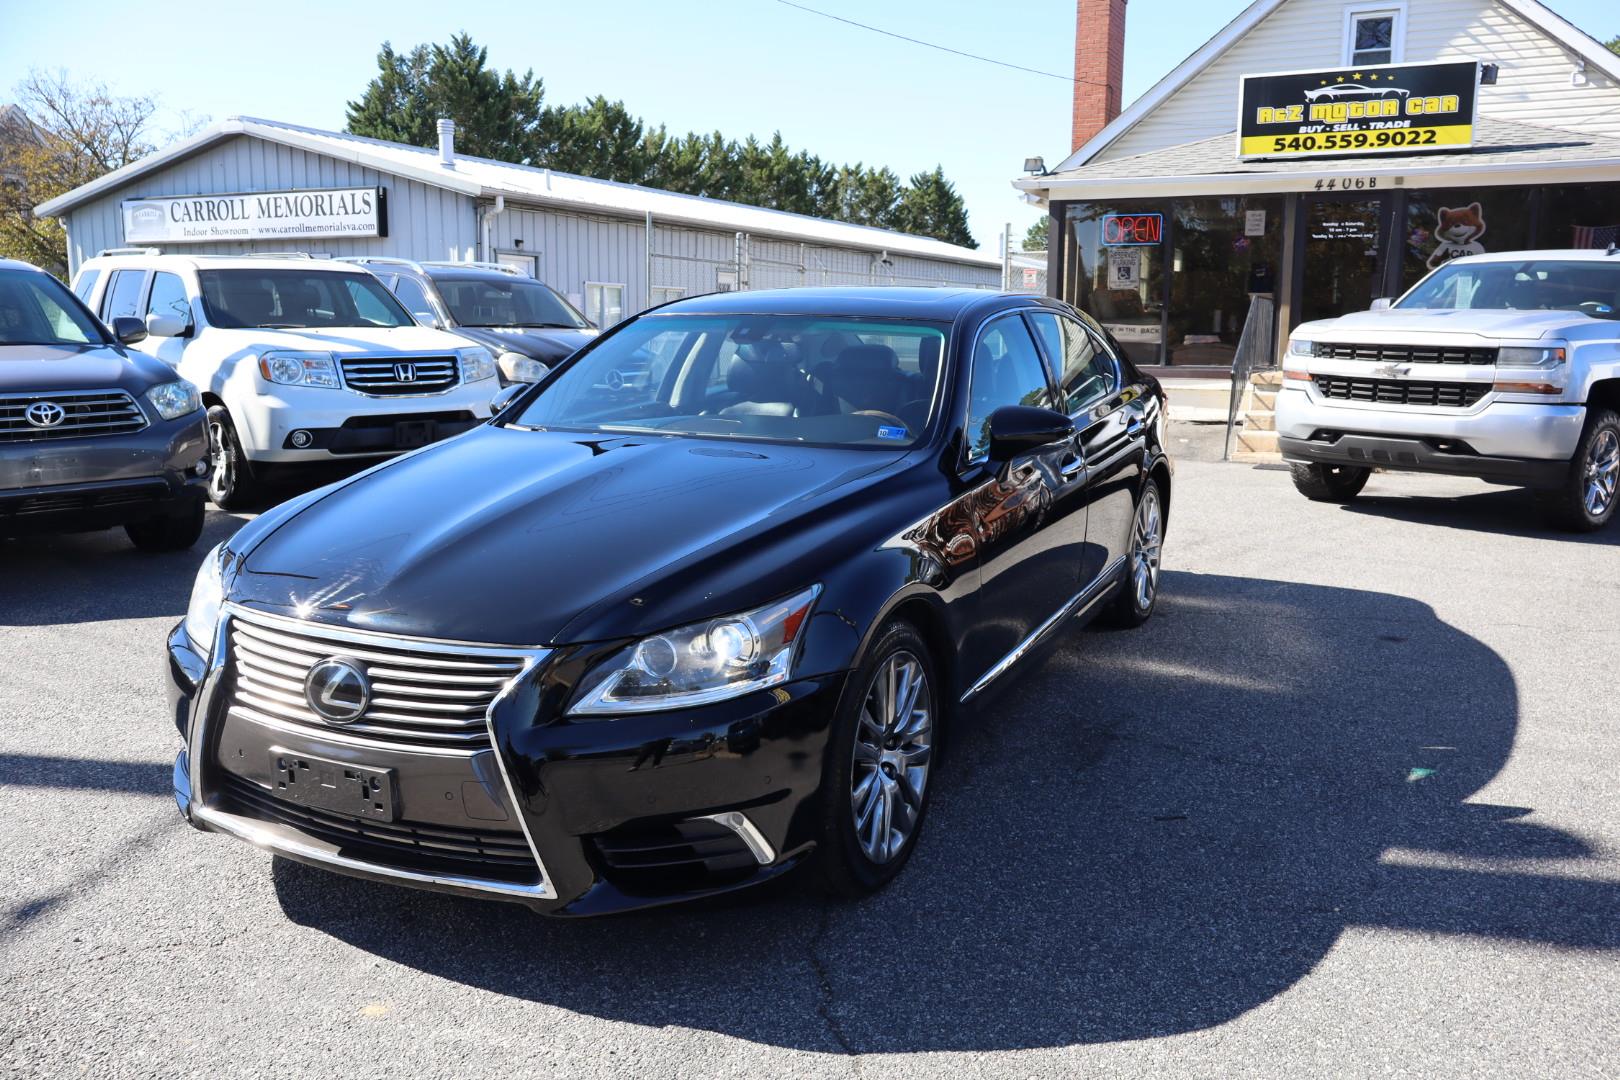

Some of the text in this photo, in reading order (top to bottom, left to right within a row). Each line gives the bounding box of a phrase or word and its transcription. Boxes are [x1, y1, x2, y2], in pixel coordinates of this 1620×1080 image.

[1298, 120, 1411, 133] BUY SELL TRADE
[1273, 130, 1437, 152] 540.559.9022
[170, 192, 372, 223] CARROLL MEMORIALS
[183, 222, 376, 236] Indoor Showroom www.carrollmemorialsva.com
[1105, 217, 1160, 242] OPEN
